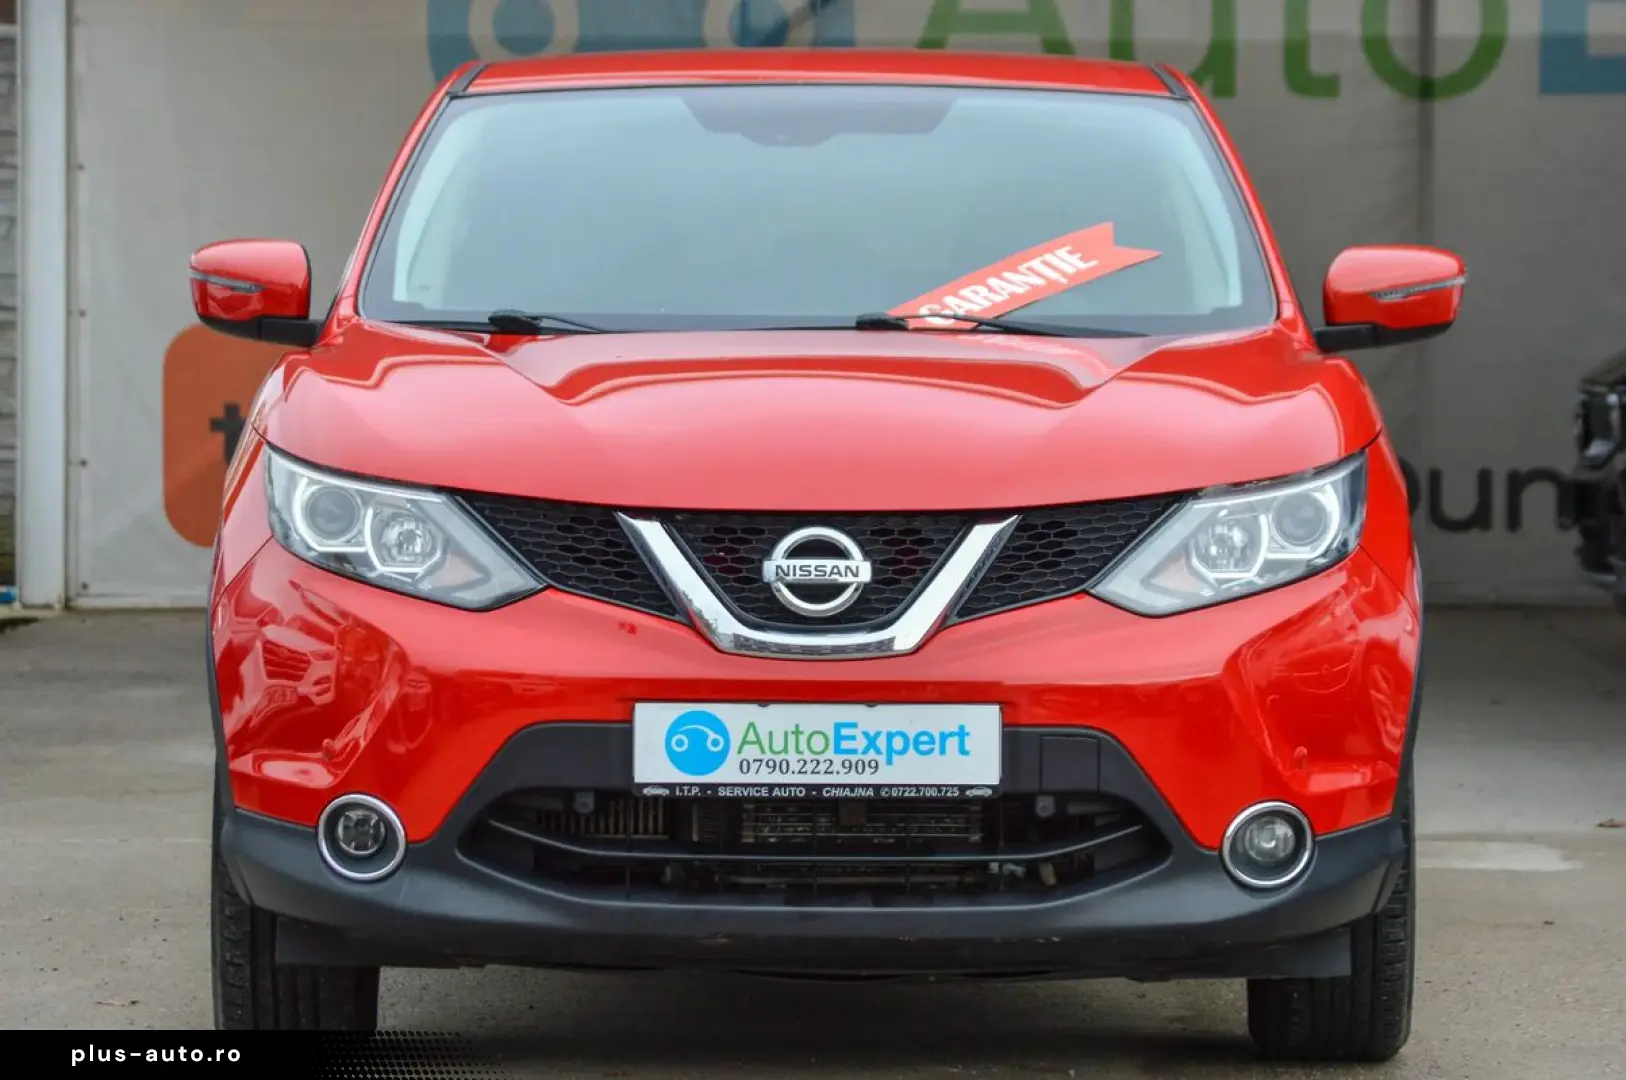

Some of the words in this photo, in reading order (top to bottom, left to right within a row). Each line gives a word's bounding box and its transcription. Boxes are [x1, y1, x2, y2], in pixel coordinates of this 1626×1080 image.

[775, 564, 860, 578] NISSAN
[736, 721, 972, 766] AutoExpert
[738, 758, 880, 776] 0790.222.909
[675, 786, 701, 797] I.T.P.
[718, 786, 769, 797] SERVICE
[772, 787, 806, 797] AUTO
[822, 787, 875, 797] CHIAJNA
[891, 787, 960, 797] 0722.700.725
